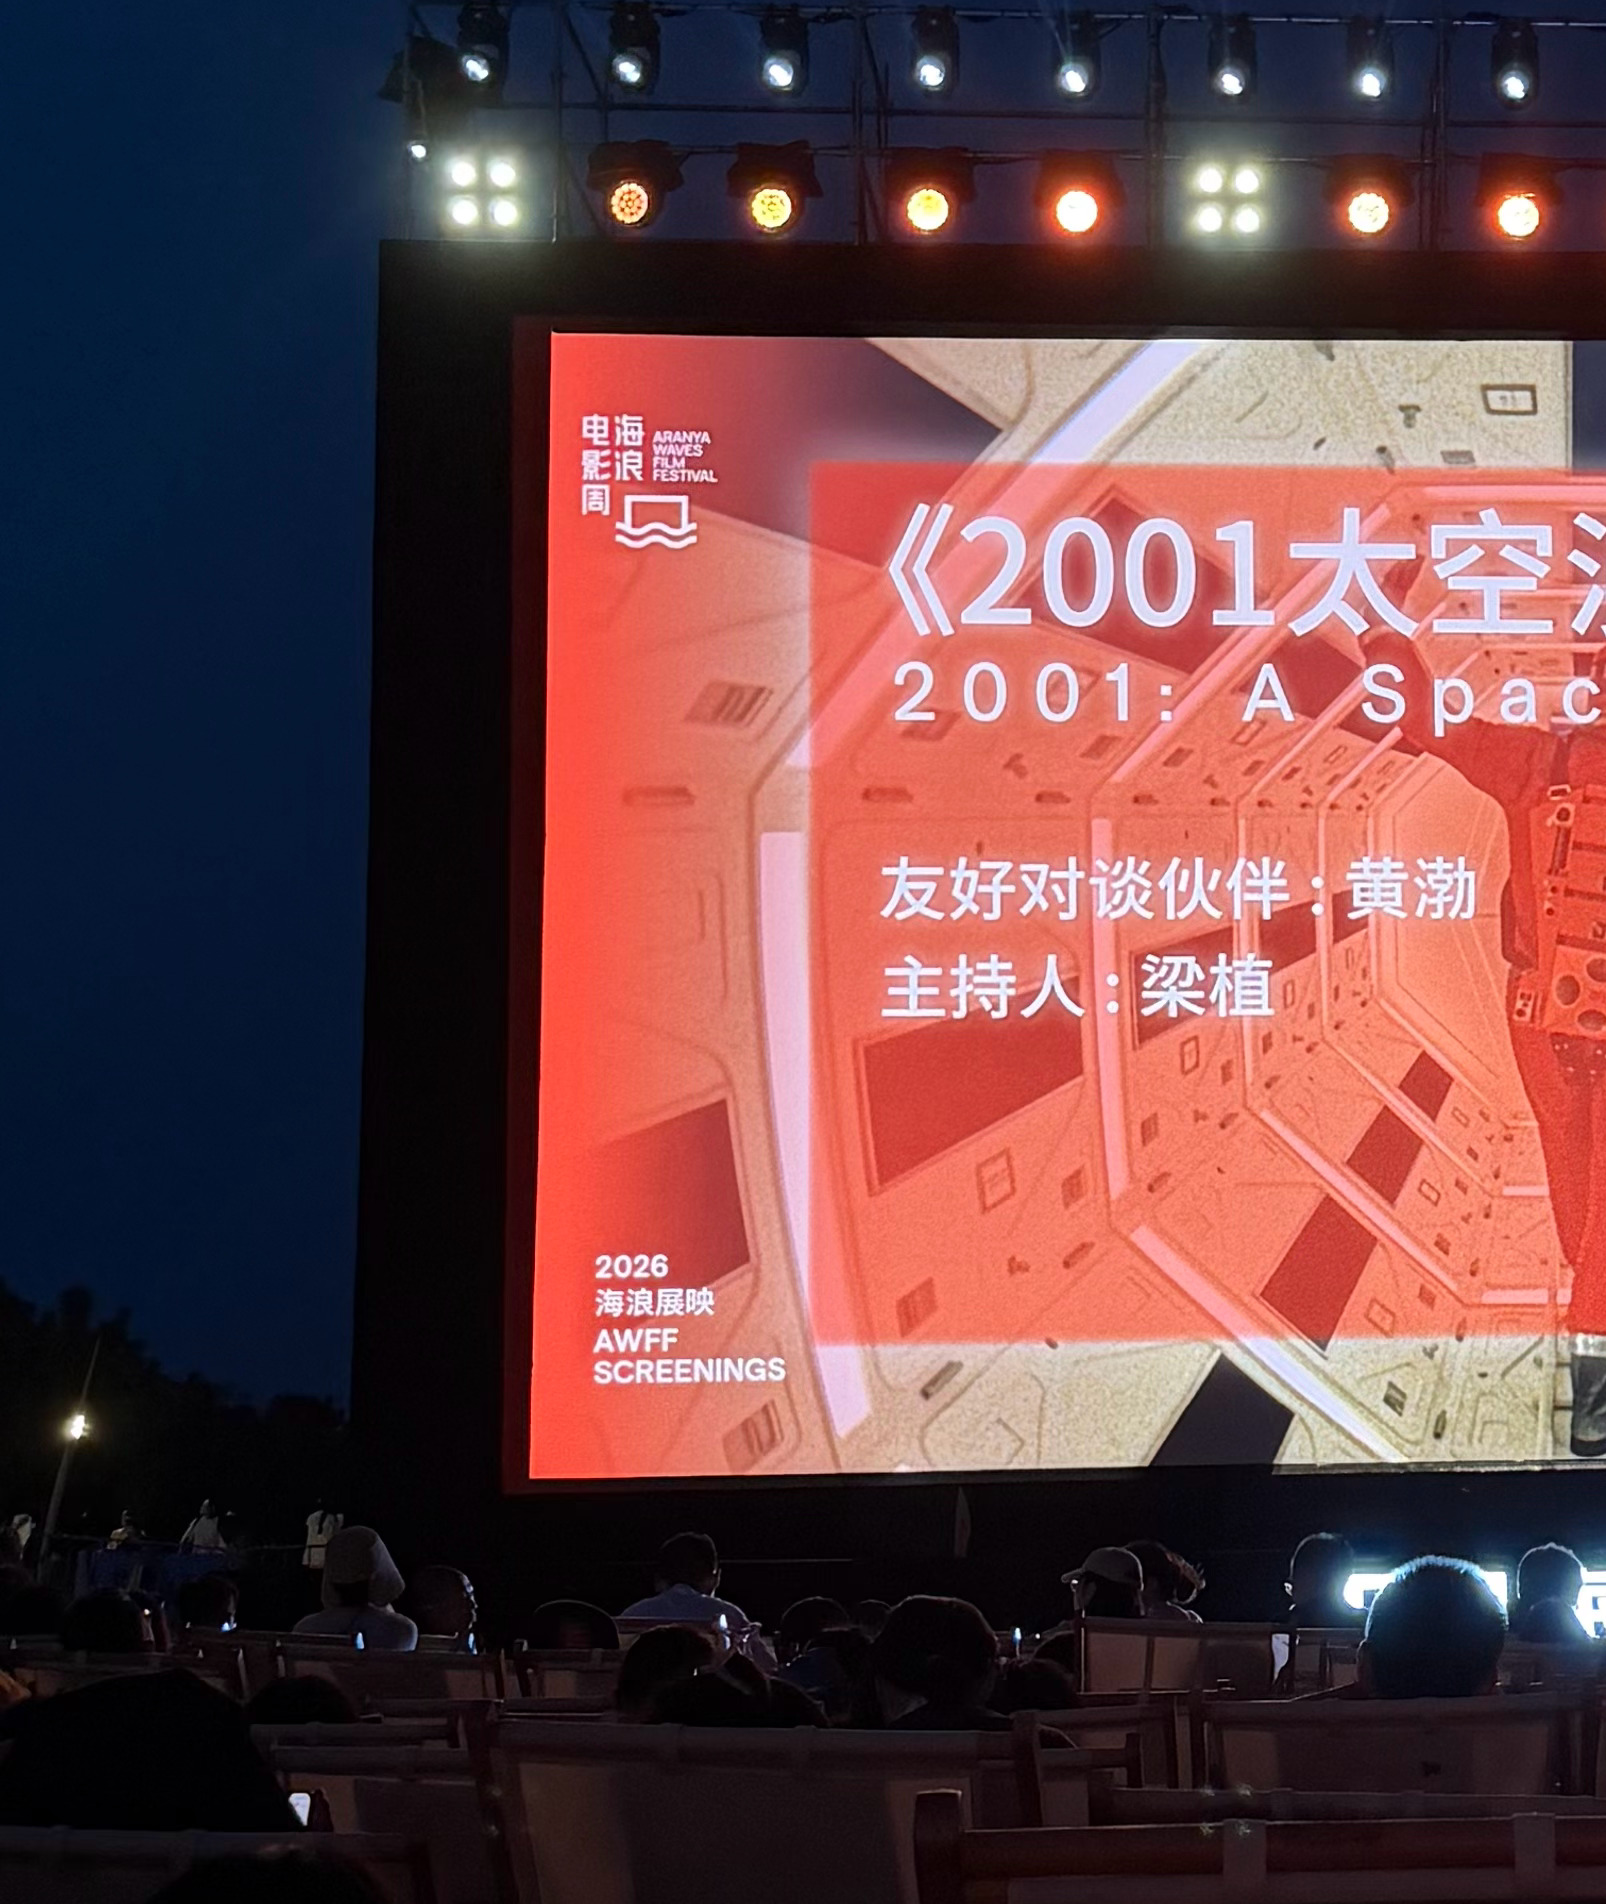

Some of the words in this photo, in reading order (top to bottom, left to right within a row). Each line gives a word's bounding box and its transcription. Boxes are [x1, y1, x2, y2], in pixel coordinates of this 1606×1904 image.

[652, 430, 711, 444] ARANYA
[652, 444, 704, 457] WAVES
[652, 456, 686, 469] FILM
[652, 469, 718, 483] FESTIVAL
[894, 661, 1174, 723] 2001:
[1242, 663, 1295, 723] A
[595, 1253, 669, 1279] 2026
[595, 1286, 715, 1318] 海浪展映
[593, 1327, 679, 1353] AWFF
[593, 1356, 787, 1384] SCREENINGS
